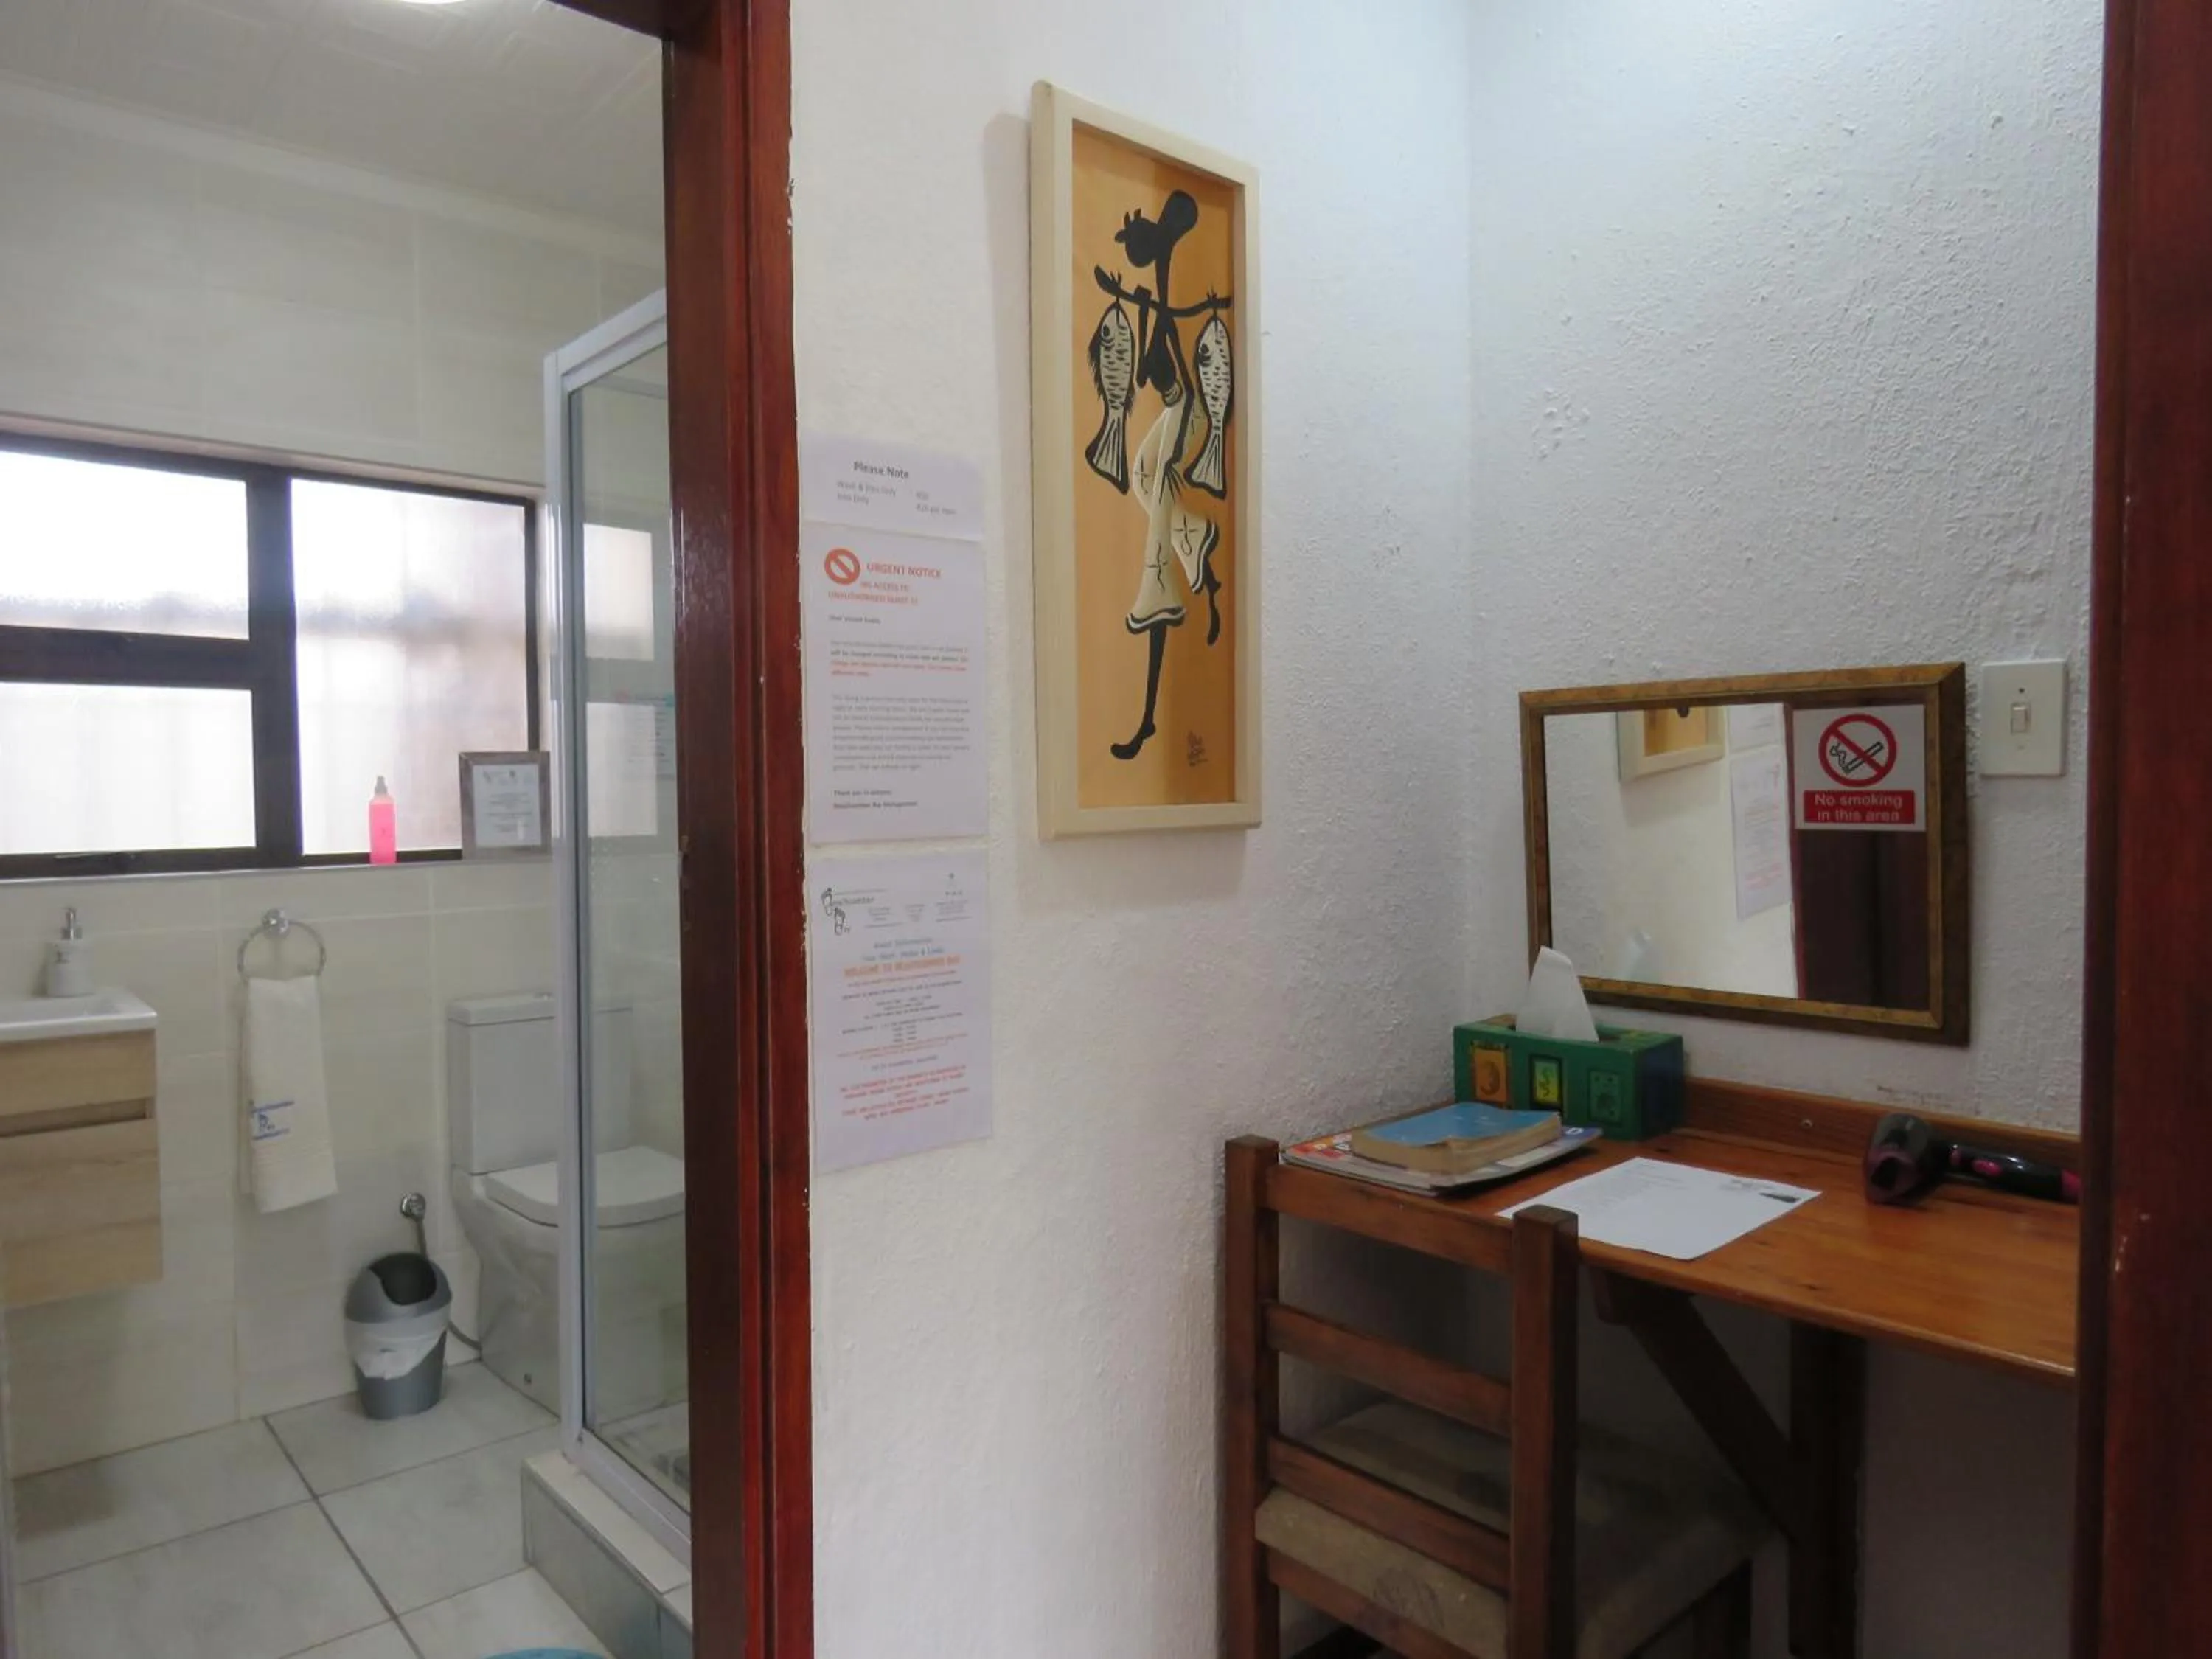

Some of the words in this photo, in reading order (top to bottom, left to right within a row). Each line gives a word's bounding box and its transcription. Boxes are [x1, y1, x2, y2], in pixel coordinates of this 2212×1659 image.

[853, 461, 884, 476] Please
[886, 466, 909, 479] Note
[866, 562, 905, 576] URGENT
[908, 567, 942, 579] NOTICE
[1814, 793, 1835, 806] No
[1840, 793, 1903, 809] smoking
[1817, 810, 1829, 821] in
[1836, 810, 1862, 821] this
[1865, 811, 1900, 821] area
